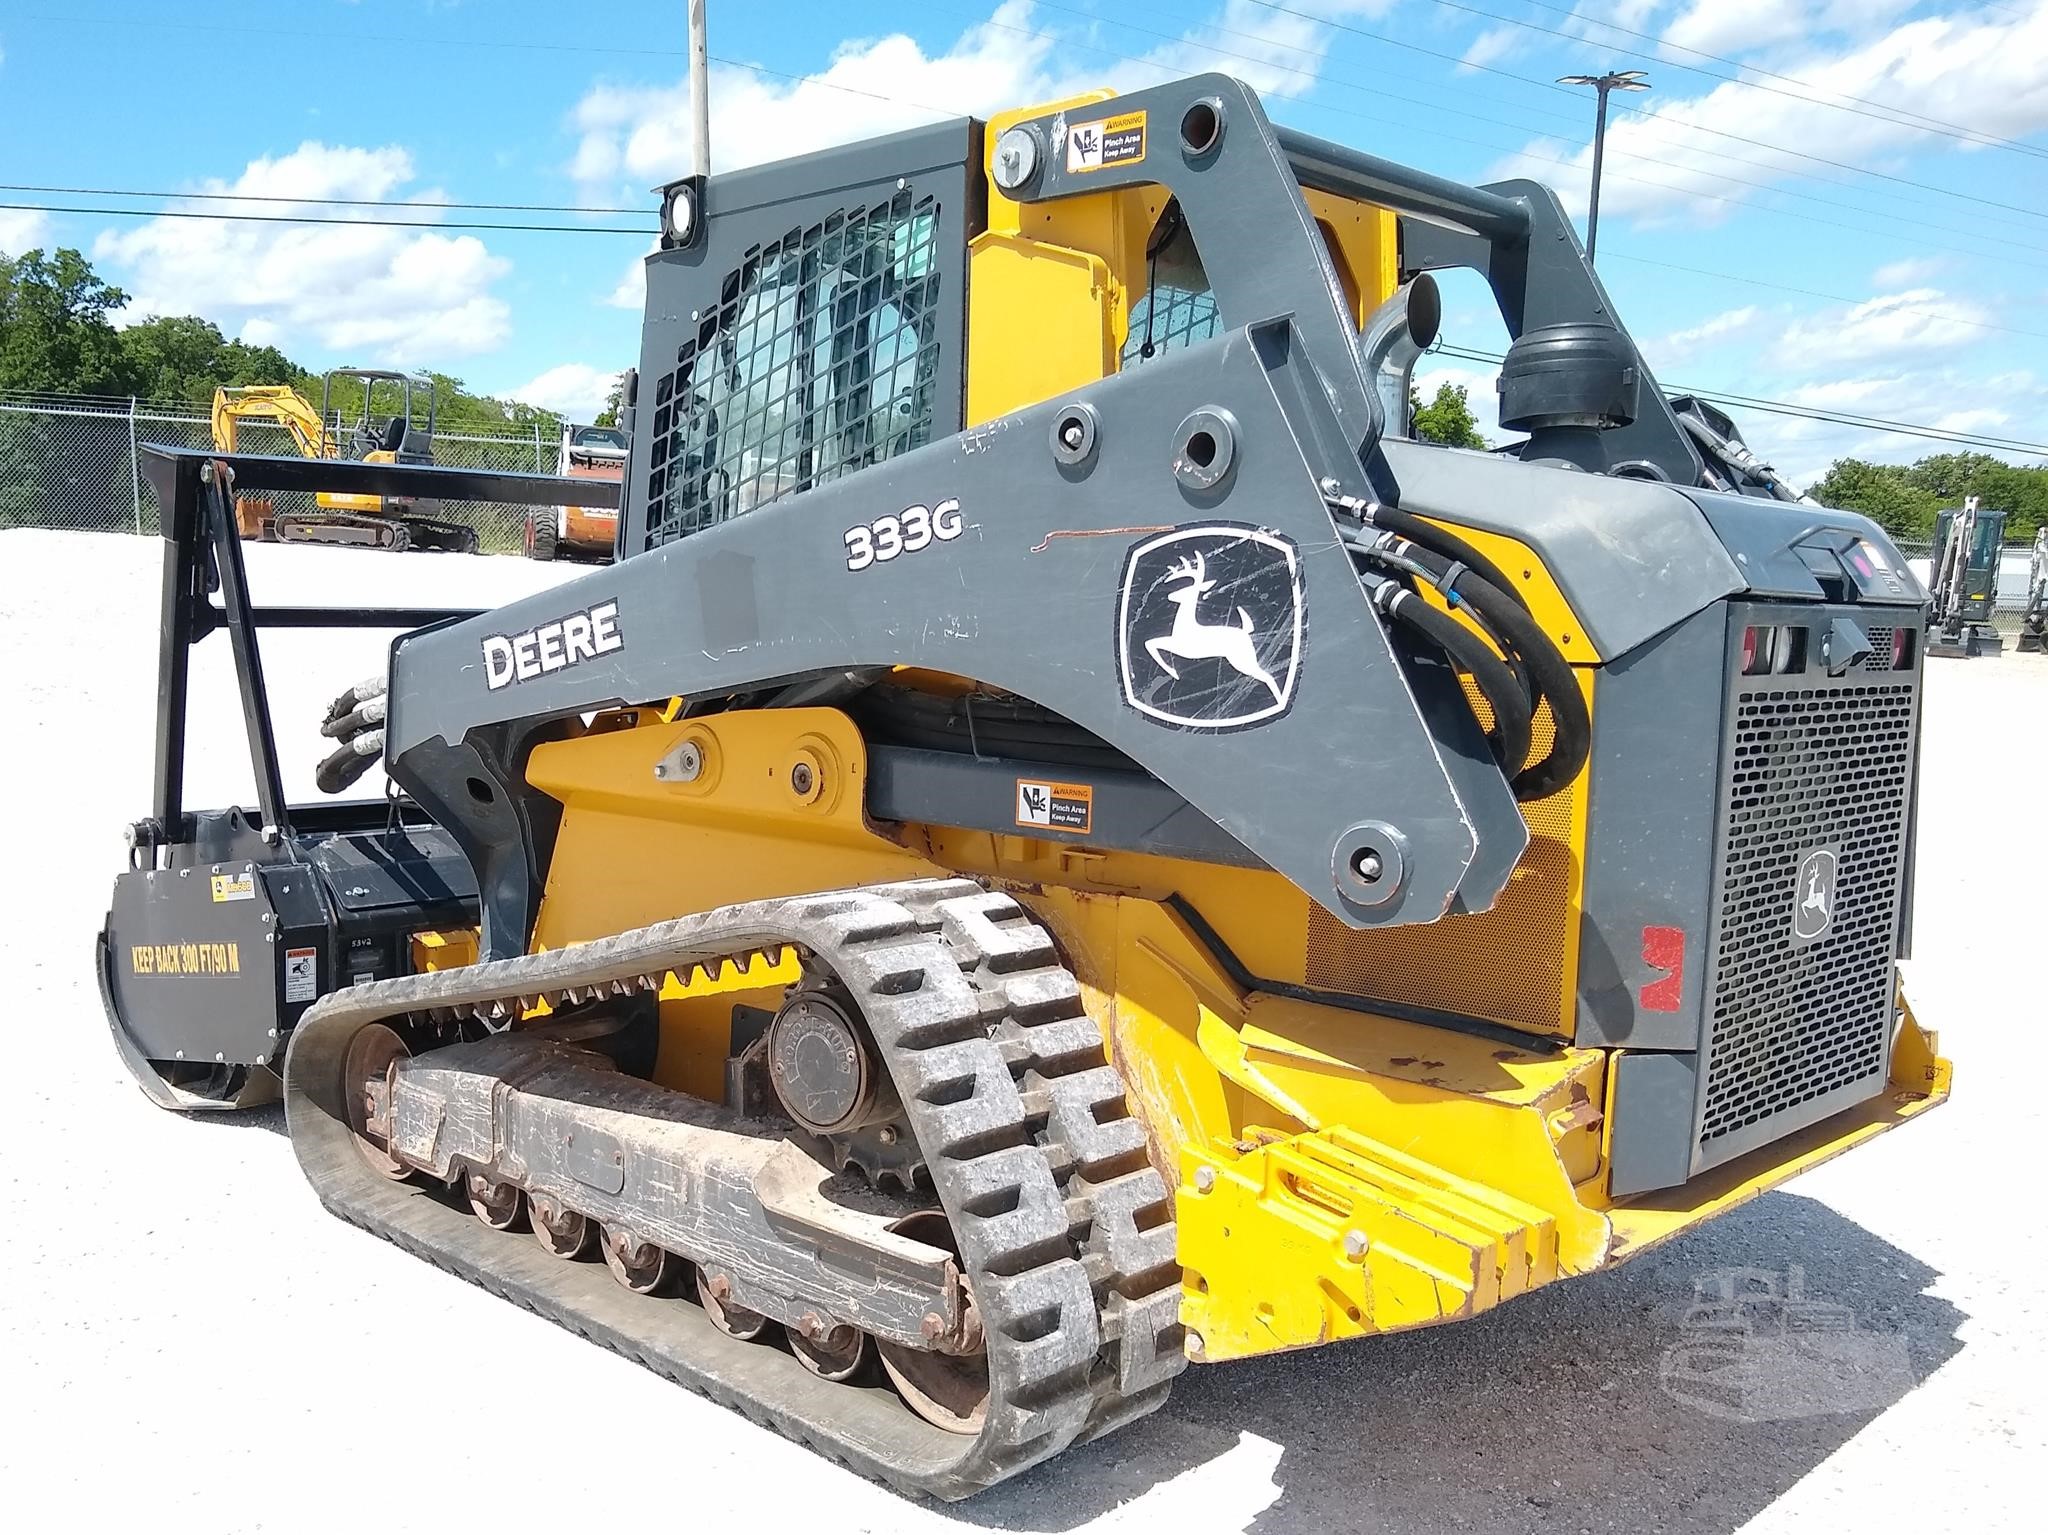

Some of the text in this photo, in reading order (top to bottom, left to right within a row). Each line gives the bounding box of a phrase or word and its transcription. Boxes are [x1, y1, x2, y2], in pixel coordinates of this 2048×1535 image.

[1111, 115, 1143, 129] WARNING
[1104, 134, 1141, 148] Pinch Area
[1104, 149, 1119, 158] Keep
[1120, 146, 1136, 155] Away
[844, 498, 963, 572] 333G
[482, 599, 623, 691] DEERE
[1059, 788, 1088, 798] WARNING
[1051, 803, 1087, 814] Pinch Area
[1051, 813, 1082, 825] Keep Away
[351, 937, 372, 948] 5342
[131, 943, 240, 976] KEEP BACK 300 FT/90 M
